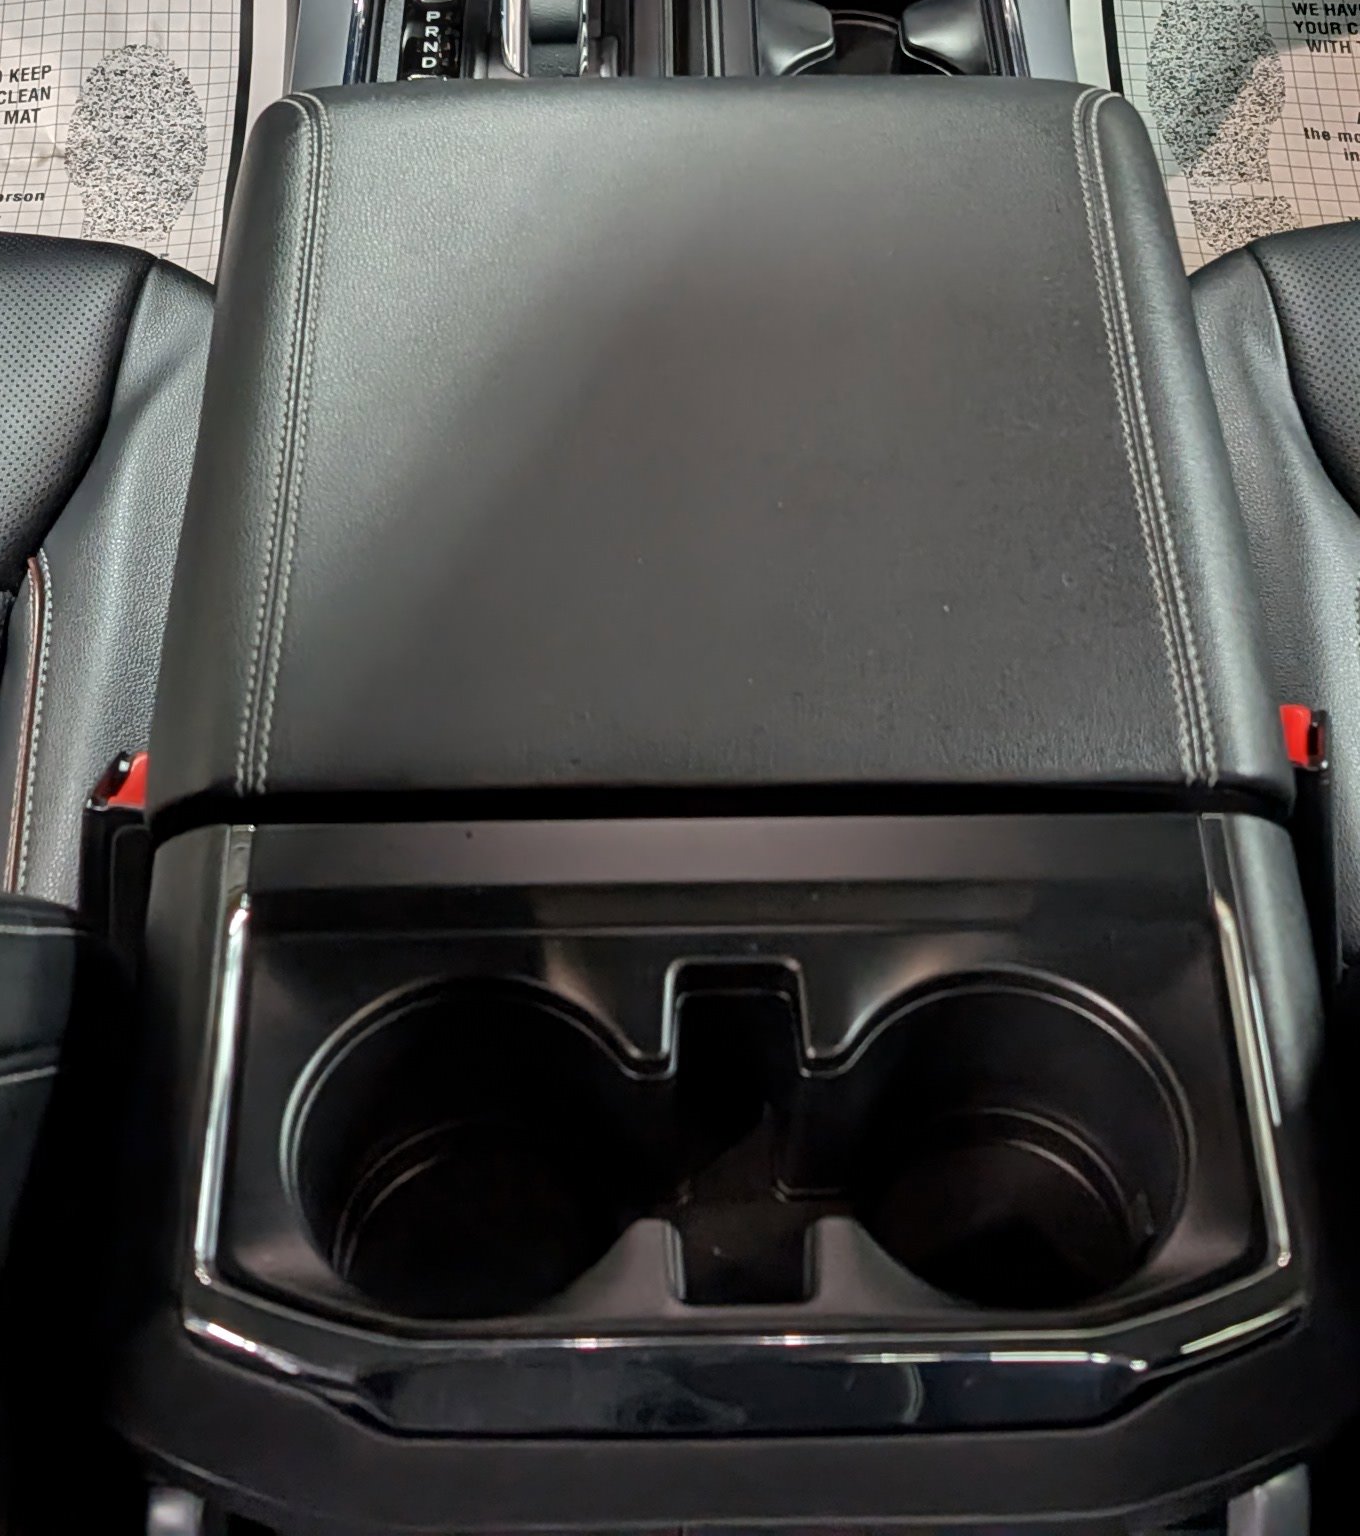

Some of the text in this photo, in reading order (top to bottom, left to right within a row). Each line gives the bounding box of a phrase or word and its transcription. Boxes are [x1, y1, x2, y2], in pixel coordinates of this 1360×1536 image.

[426, 10, 441, 22] P
[1292, 2, 1319, 16] WE
[425, 26, 439, 38] R
[1293, 20, 1342, 35] YOUR
[423, 41, 438, 53] N
[1306, 39, 1352, 54] WITH
[421, 56, 437, 69] D
[9, 65, 52, 83] KEEP
[3, 108, 42, 125] MAT
[1304, 127, 1331, 141] the
[1343, 148, 1360, 162] in
